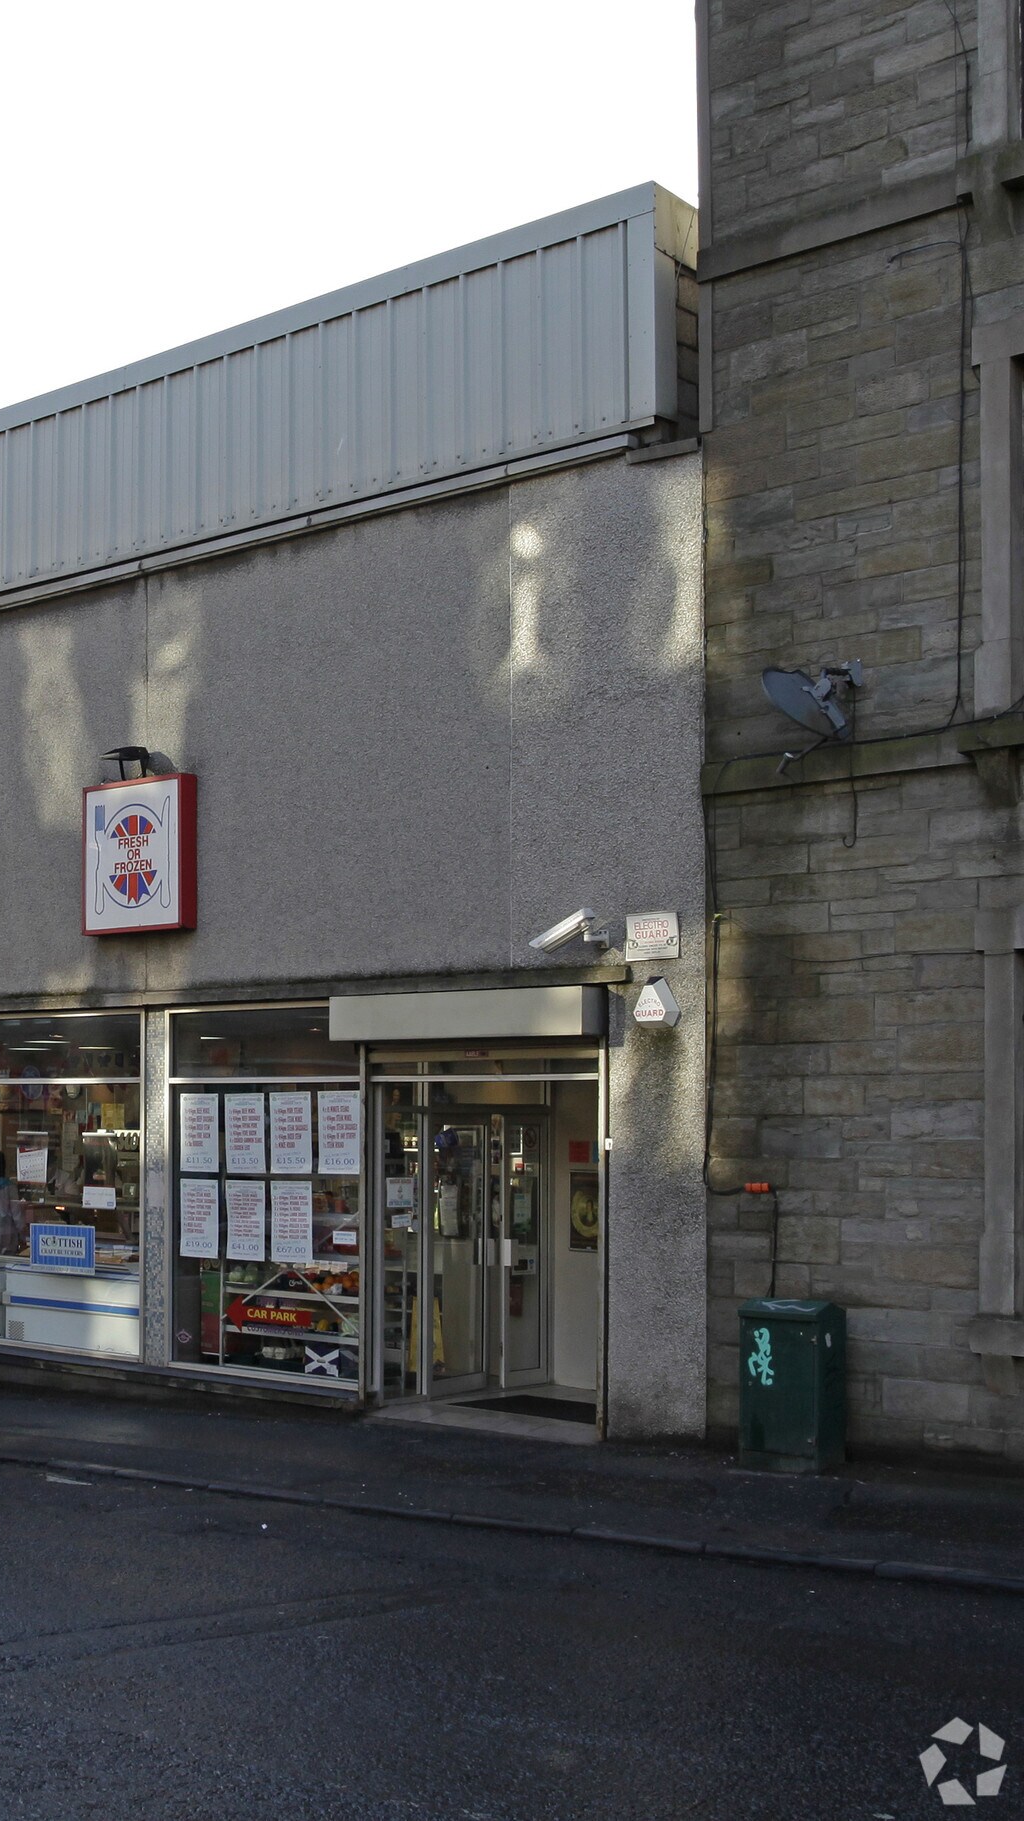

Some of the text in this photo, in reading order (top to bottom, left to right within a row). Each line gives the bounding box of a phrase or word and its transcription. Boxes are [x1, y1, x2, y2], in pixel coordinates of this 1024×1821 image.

[118, 836, 149, 849] FRESH
[127, 849, 141, 860] OR
[114, 859, 152, 873] FROZEN
[634, 919, 670, 931] ELECTRO
[634, 929, 669, 940] GUARD
[638, 997, 661, 1008] ELECTRO
[635, 1008, 664, 1018] GUARD
[185, 1156, 213, 1164] £11.50
[40, 1236, 83, 1249] SCOTTISH
[231, 1242, 259, 1251] £41.00
[246, 1308, 297, 1323] CAR PARK
